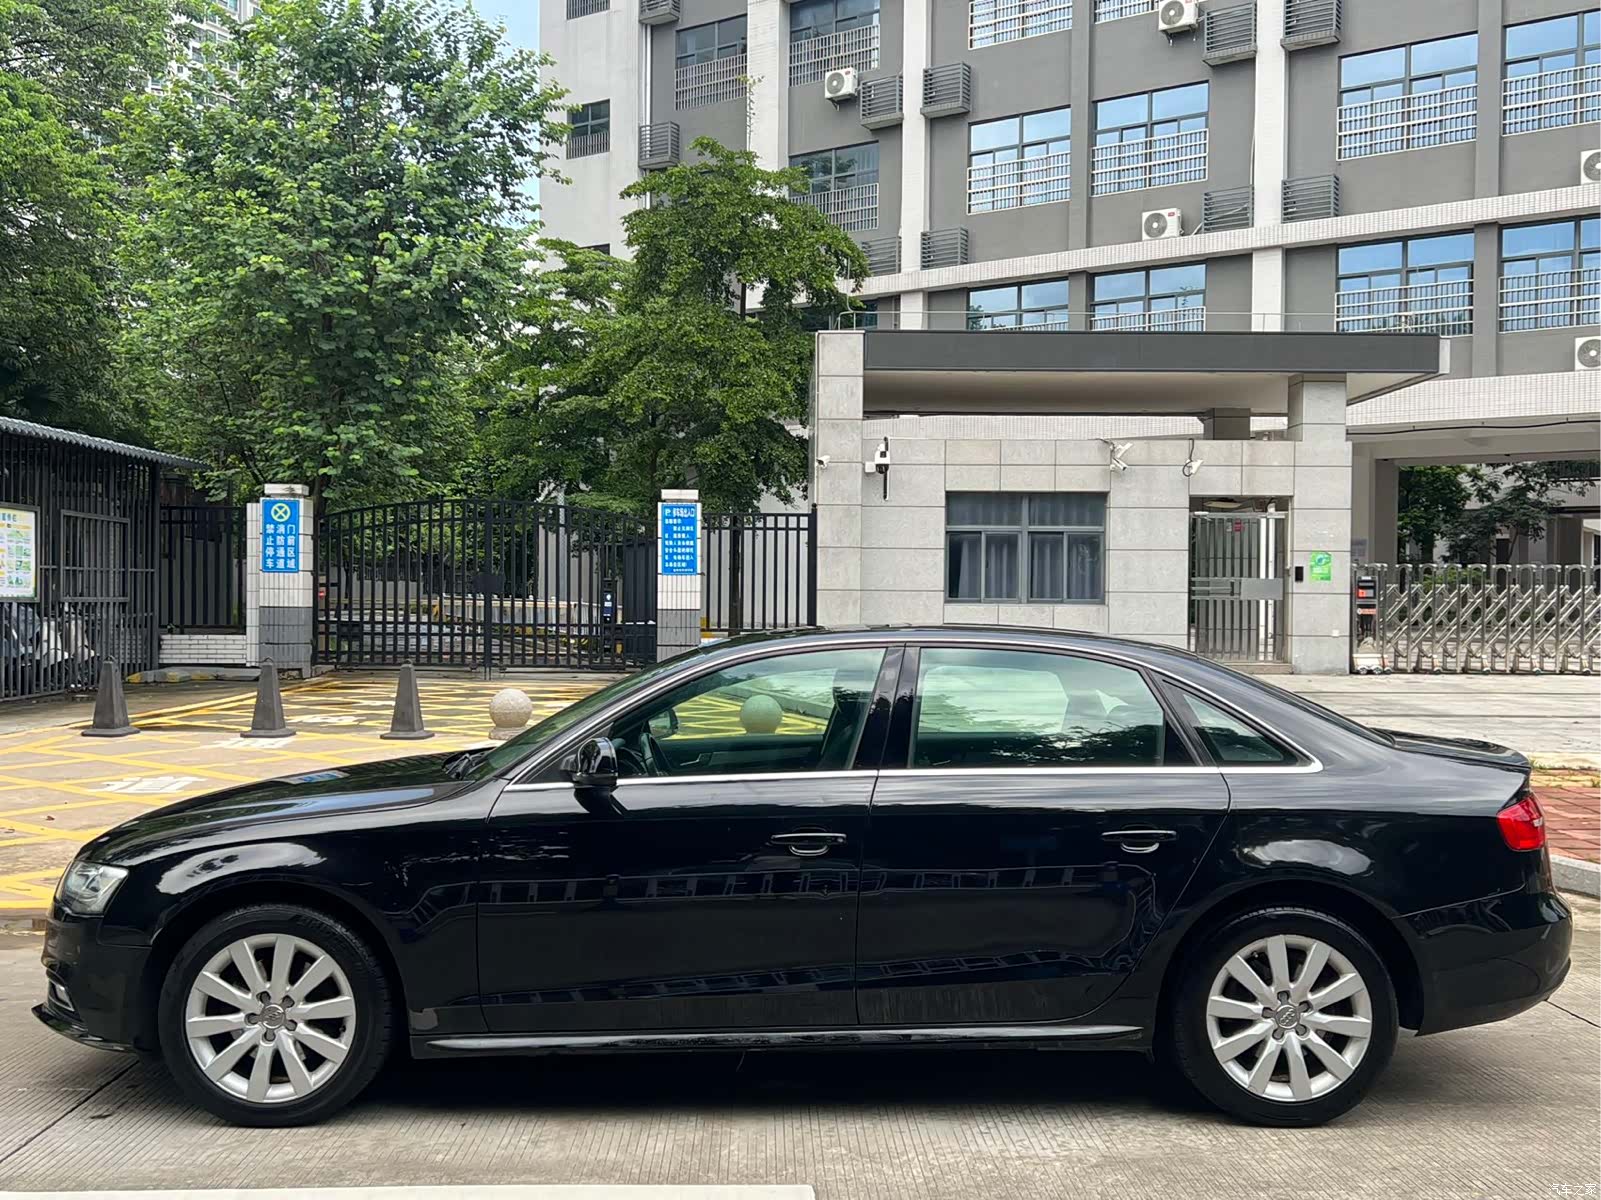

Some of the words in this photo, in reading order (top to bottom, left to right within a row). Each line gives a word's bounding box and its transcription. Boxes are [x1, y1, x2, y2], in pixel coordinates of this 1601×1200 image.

[265, 523, 275, 569] 禁止停车
[275, 523, 286, 569] 消防通道
[286, 523, 296, 569] 门前区域
